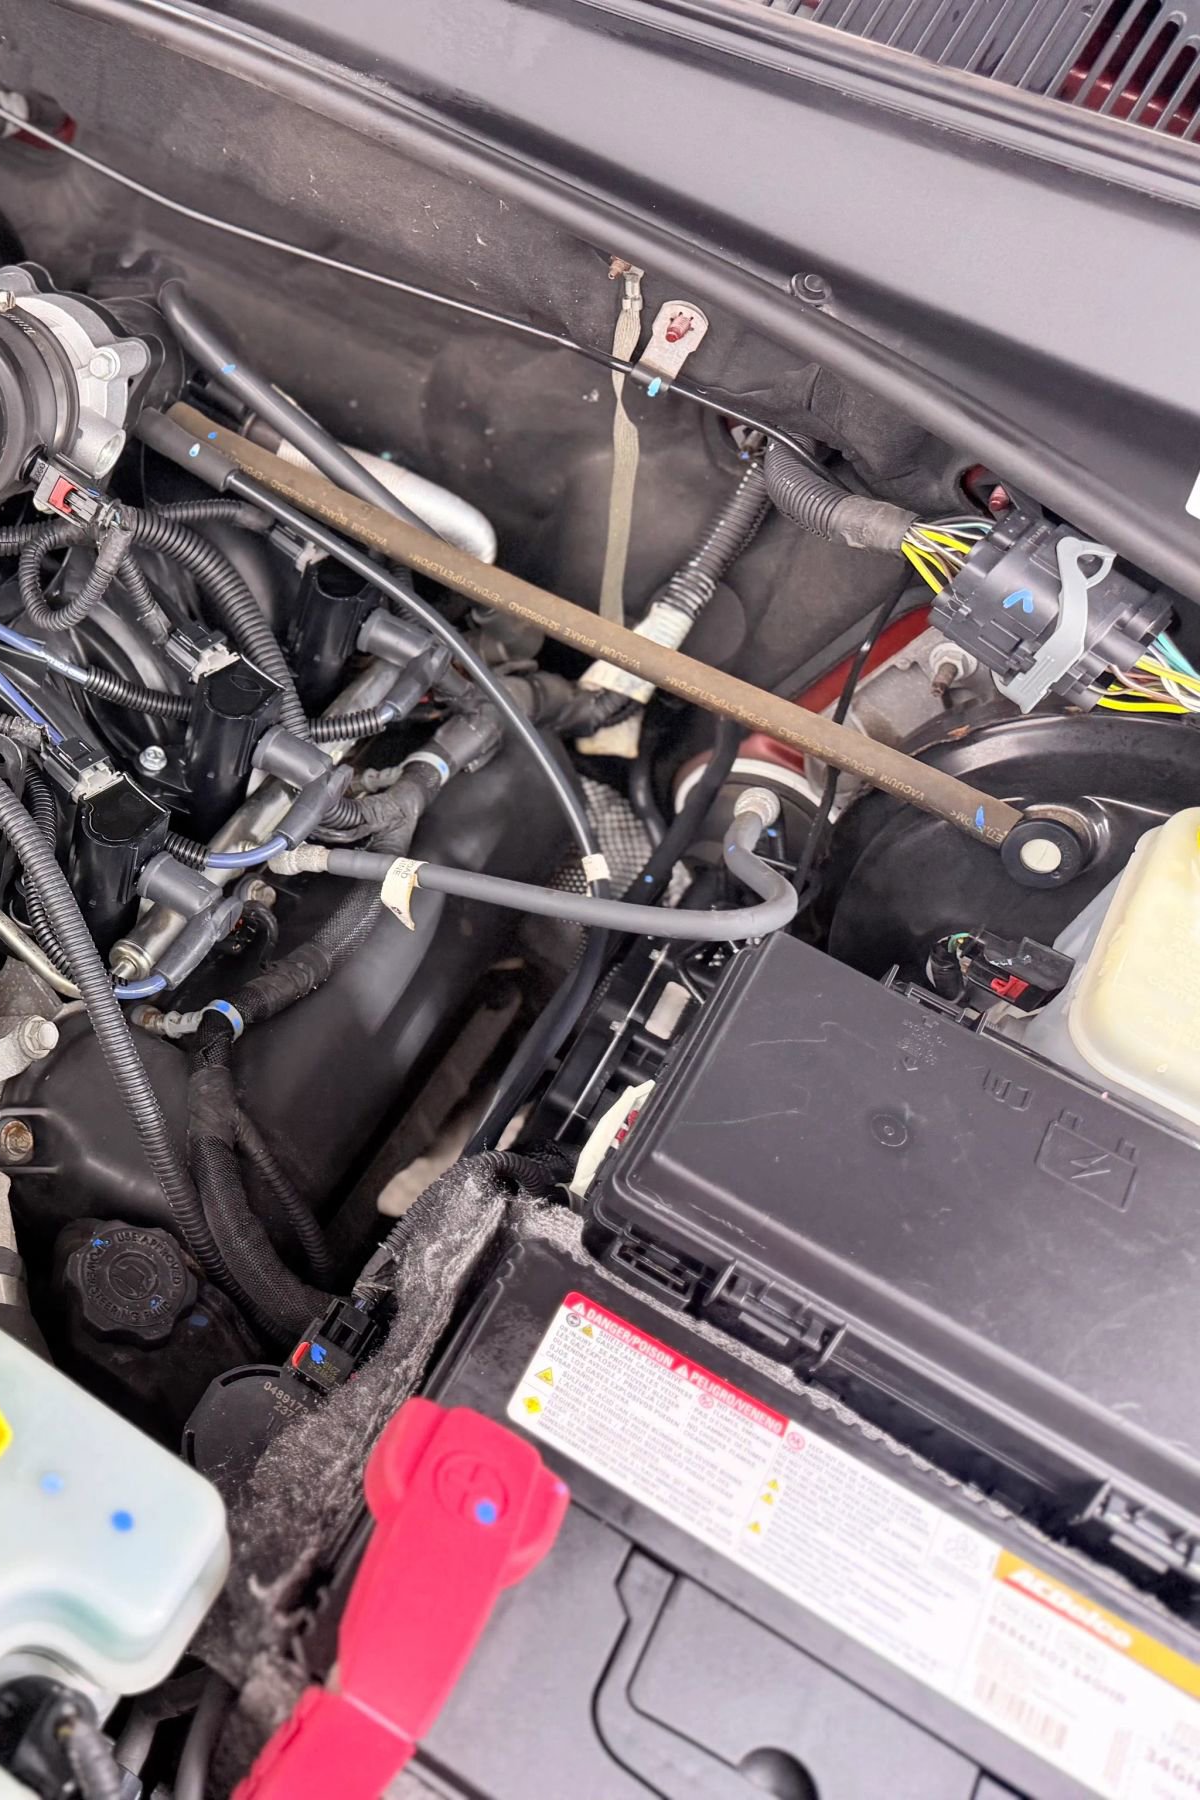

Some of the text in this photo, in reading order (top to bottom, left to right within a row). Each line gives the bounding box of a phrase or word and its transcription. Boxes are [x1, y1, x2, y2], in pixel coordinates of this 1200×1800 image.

[349, 519, 388, 546] VACUUM
[562, 624, 597, 650] BRAKE
[598, 641, 642, 672] VACUUM
[878, 769, 926, 802] VACUUM
[115, 1231, 139, 1242] USE
[585, 1307, 676, 1368] DANGER/POISON
[687, 1370, 784, 1434] PELIGRO/VENENO
